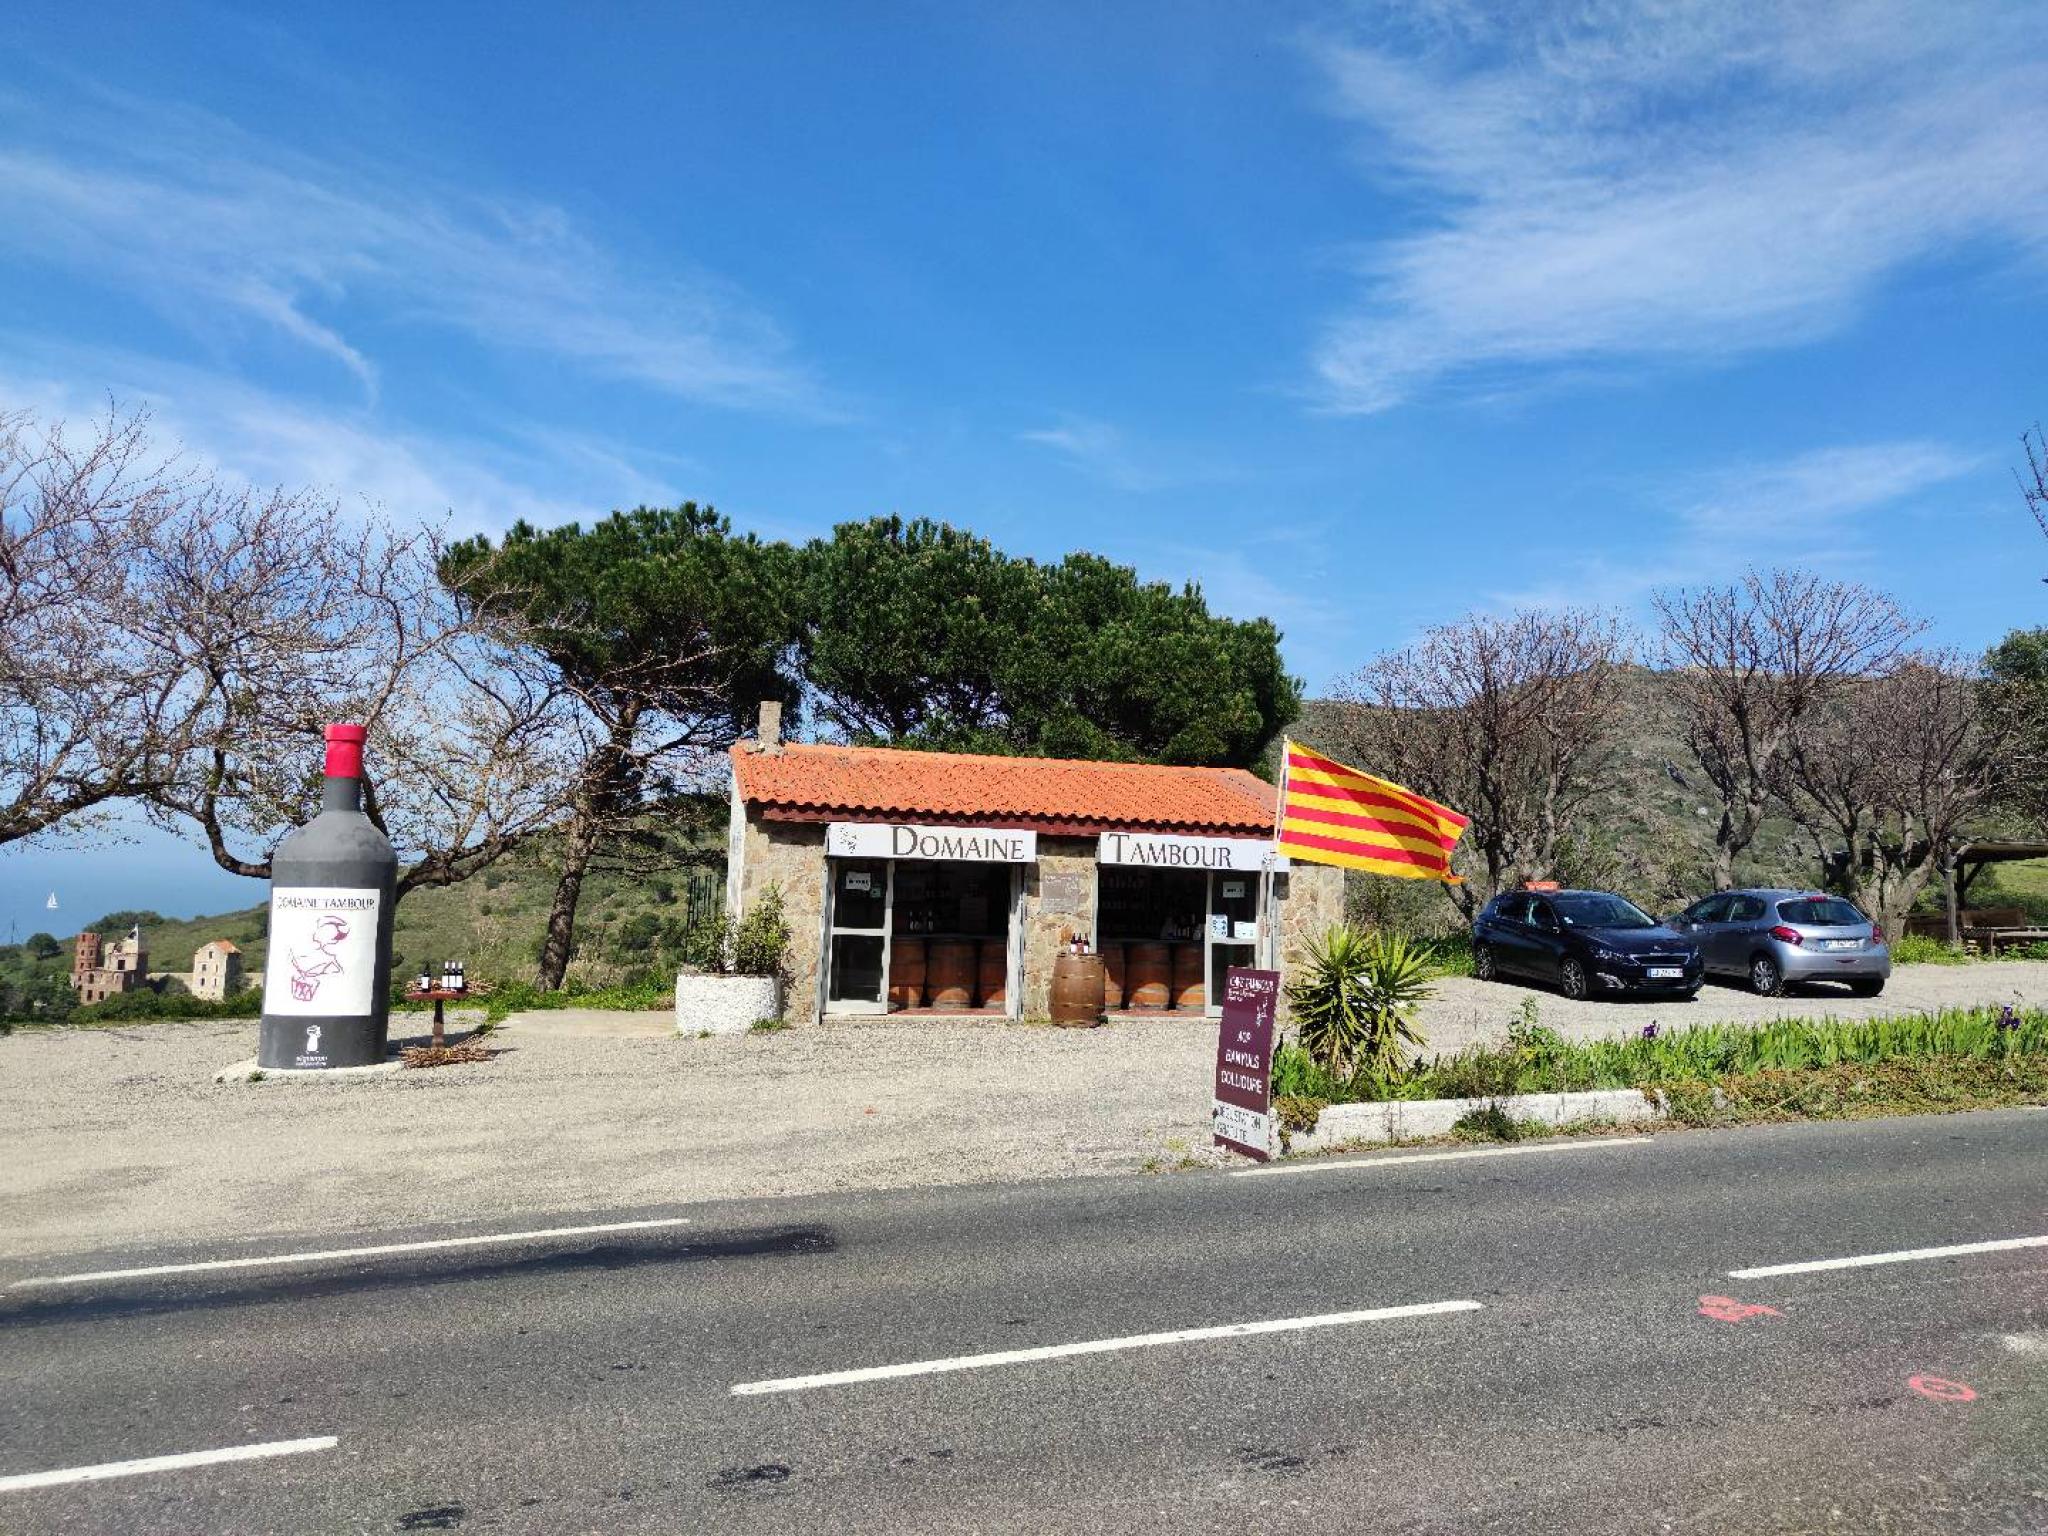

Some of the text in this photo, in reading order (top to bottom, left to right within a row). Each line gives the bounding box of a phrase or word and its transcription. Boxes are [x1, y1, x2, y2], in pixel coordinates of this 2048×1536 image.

[892, 826, 1233, 868] DOMAINE TAMBOUR
[1225, 1049, 1260, 1069] BANYULS
